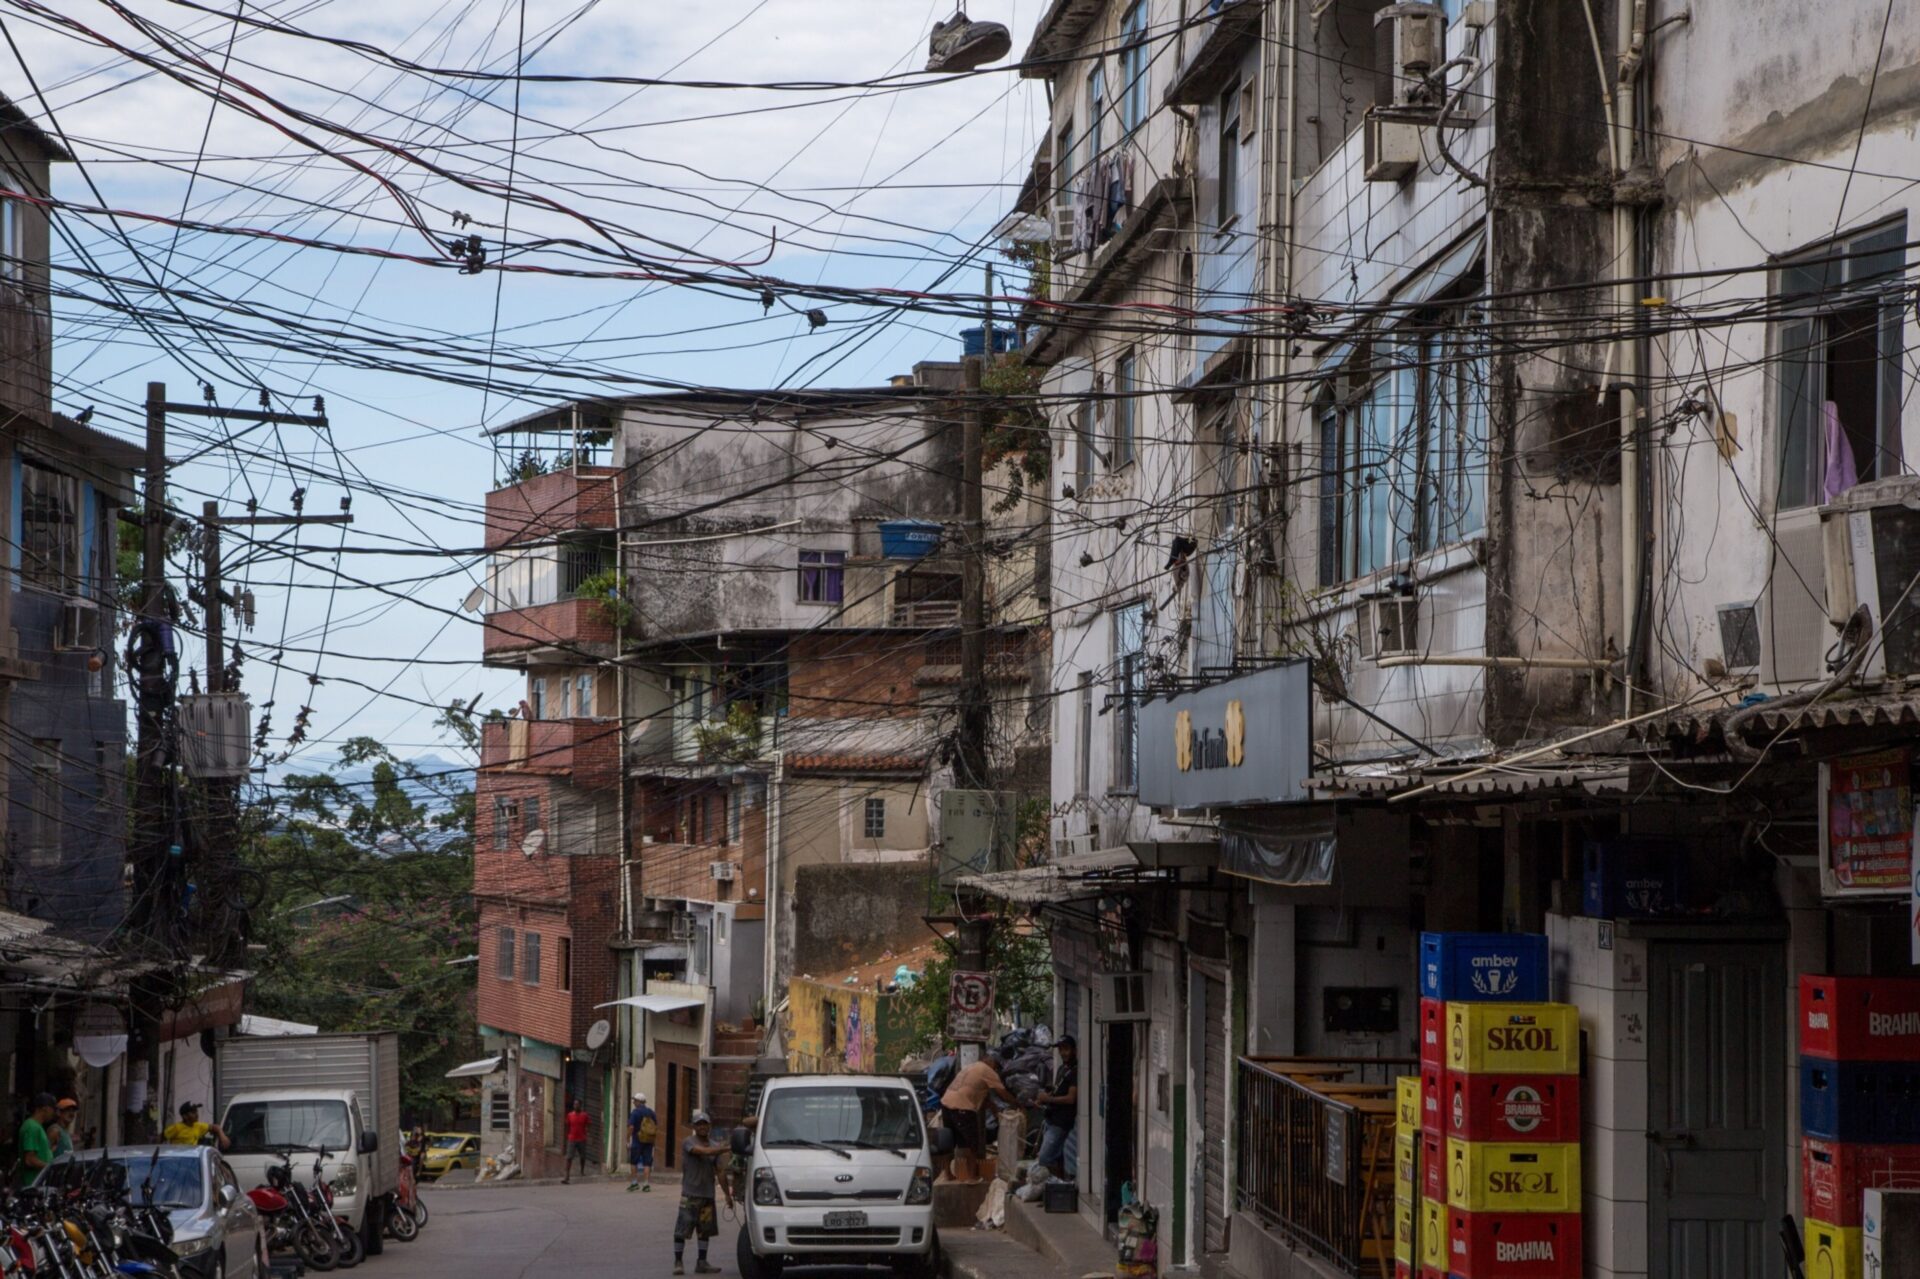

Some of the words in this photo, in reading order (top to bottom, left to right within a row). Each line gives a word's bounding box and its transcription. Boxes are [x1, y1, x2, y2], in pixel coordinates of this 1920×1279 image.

[1472, 954, 1518, 967] ambev
[1488, 1028, 1559, 1052] SKOL
[1505, 1103, 1542, 1116] BRAHMA
[1489, 1171, 1559, 1194] SKOL
[1496, 1240, 1554, 1263] BRAHMA
